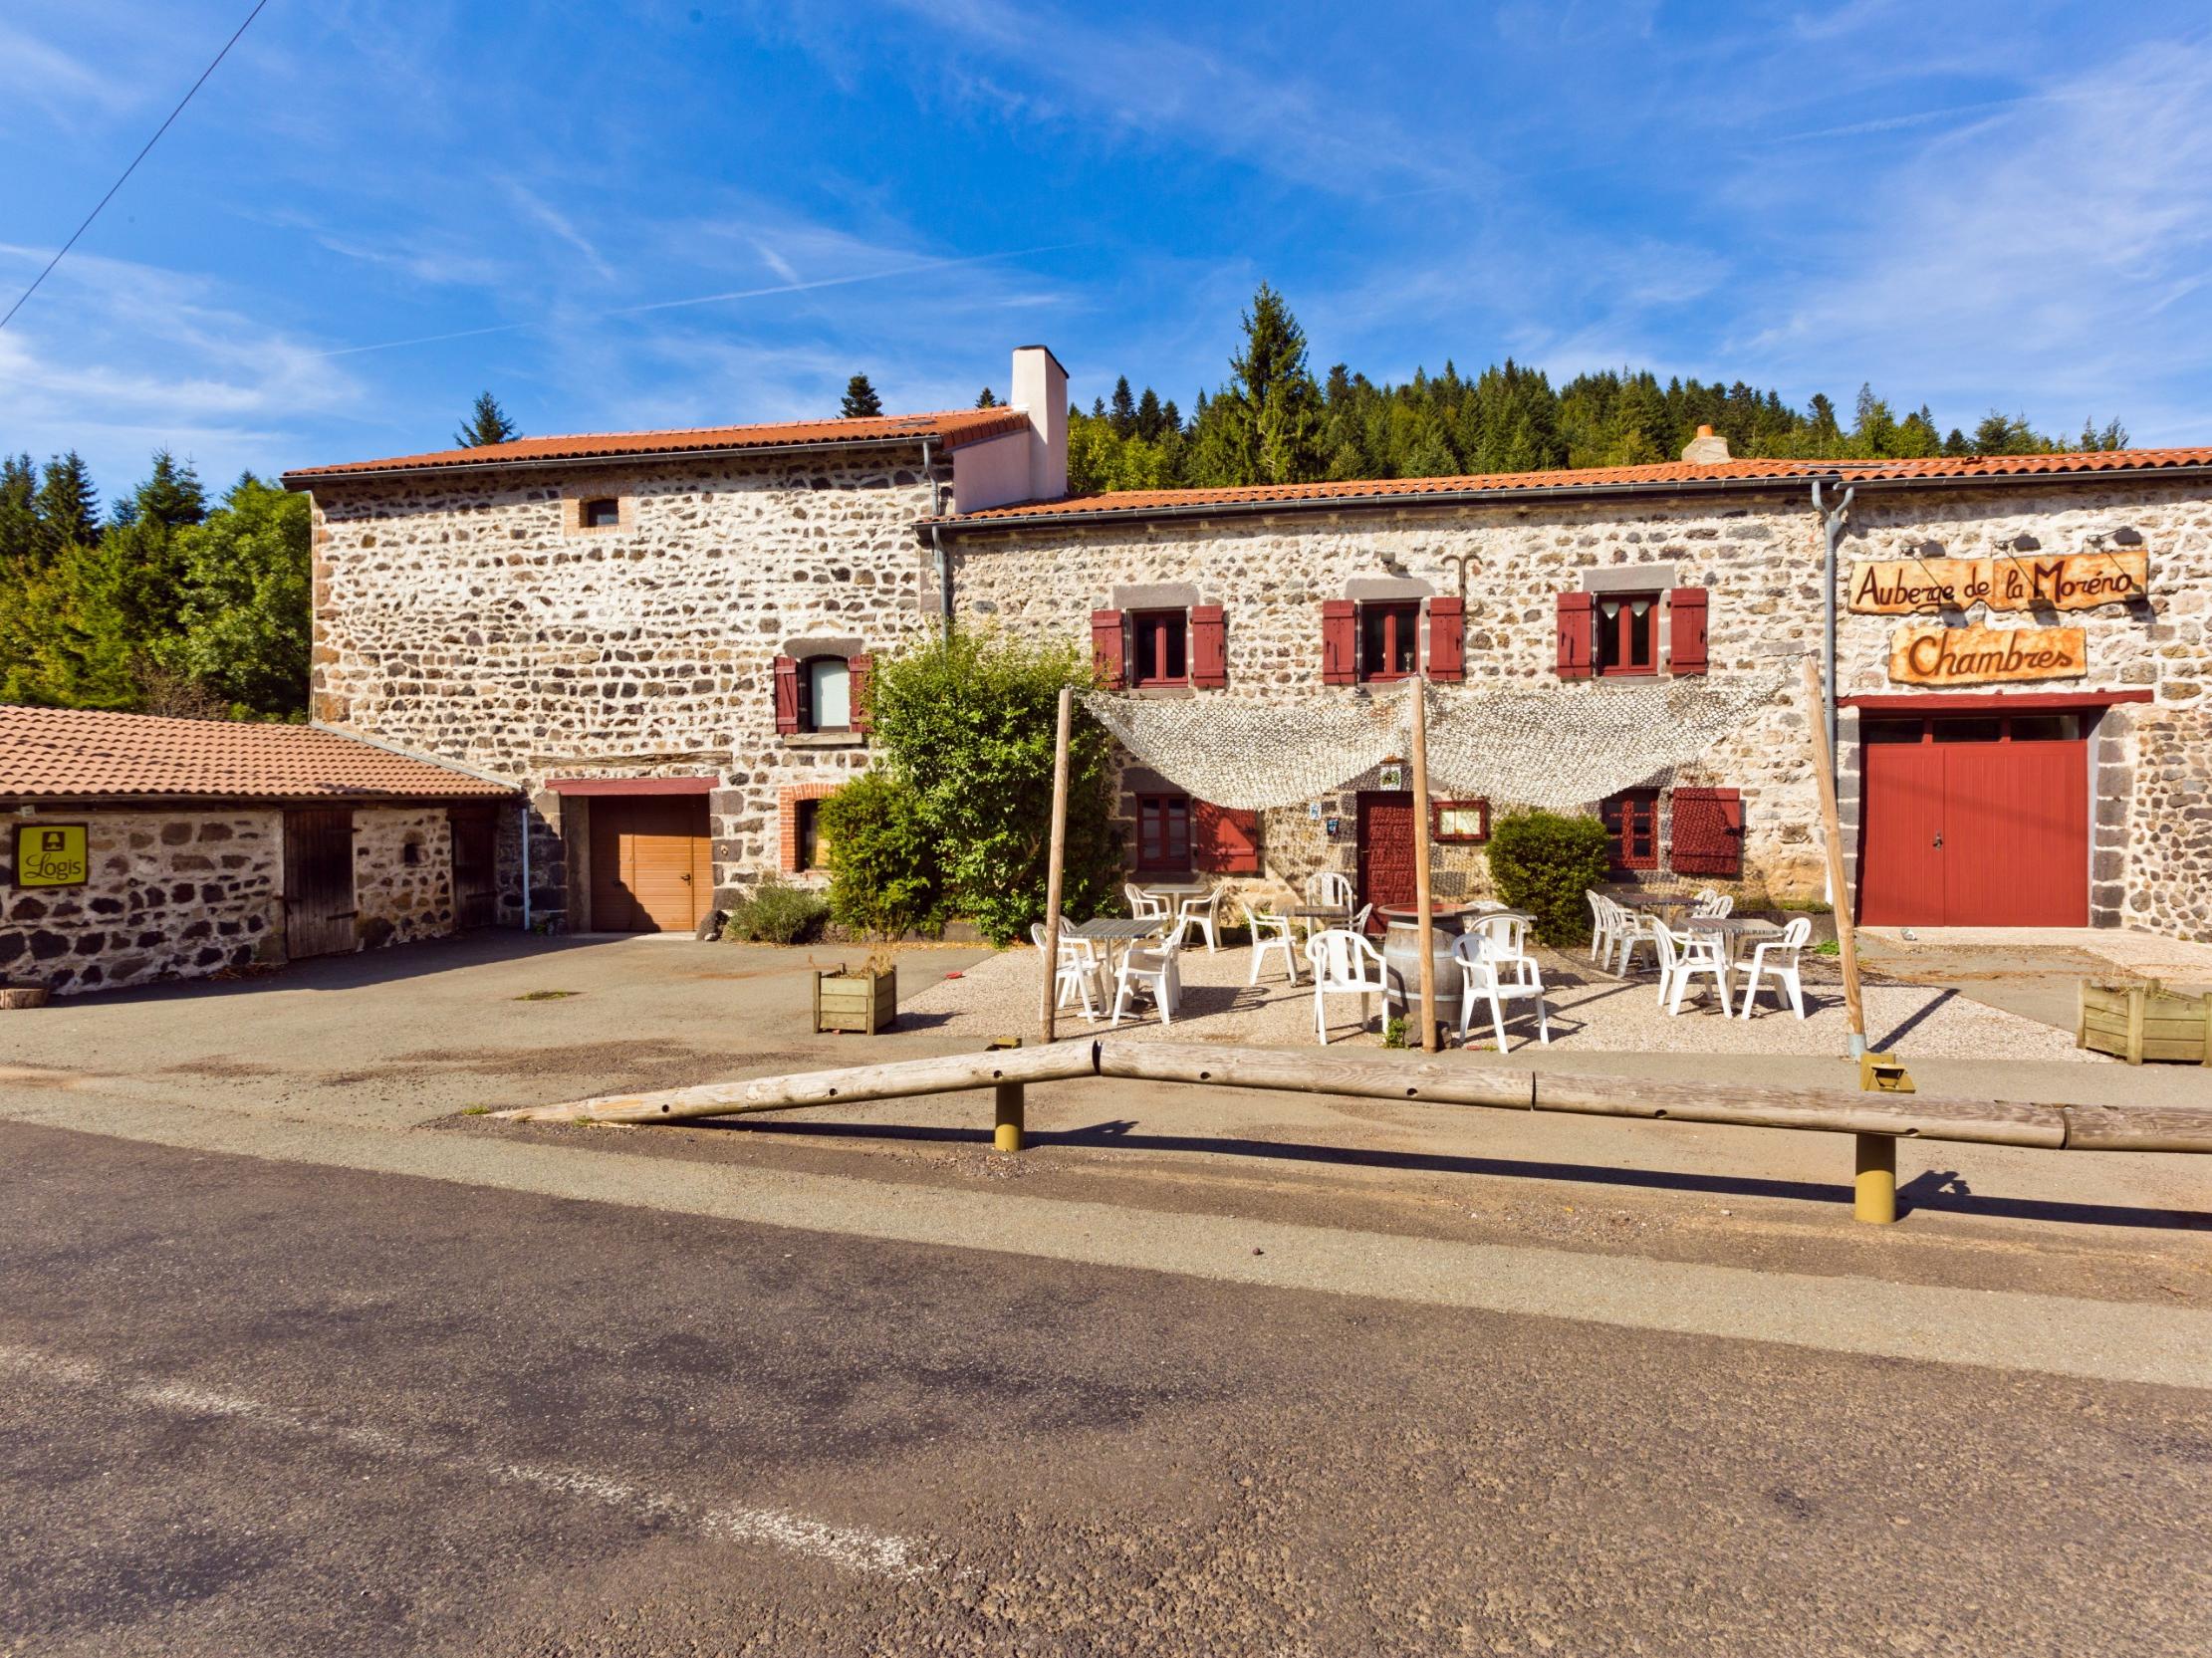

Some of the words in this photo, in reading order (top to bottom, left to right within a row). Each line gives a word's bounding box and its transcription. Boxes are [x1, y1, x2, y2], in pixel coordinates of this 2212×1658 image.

[1855, 565, 1955, 610] Auberge
[1963, 566, 1990, 597] de
[2005, 570, 2024, 599] la
[2033, 560, 2133, 603] Moréno
[1908, 630, 2073, 678] Chambres
[23, 852, 82, 881] Logis
